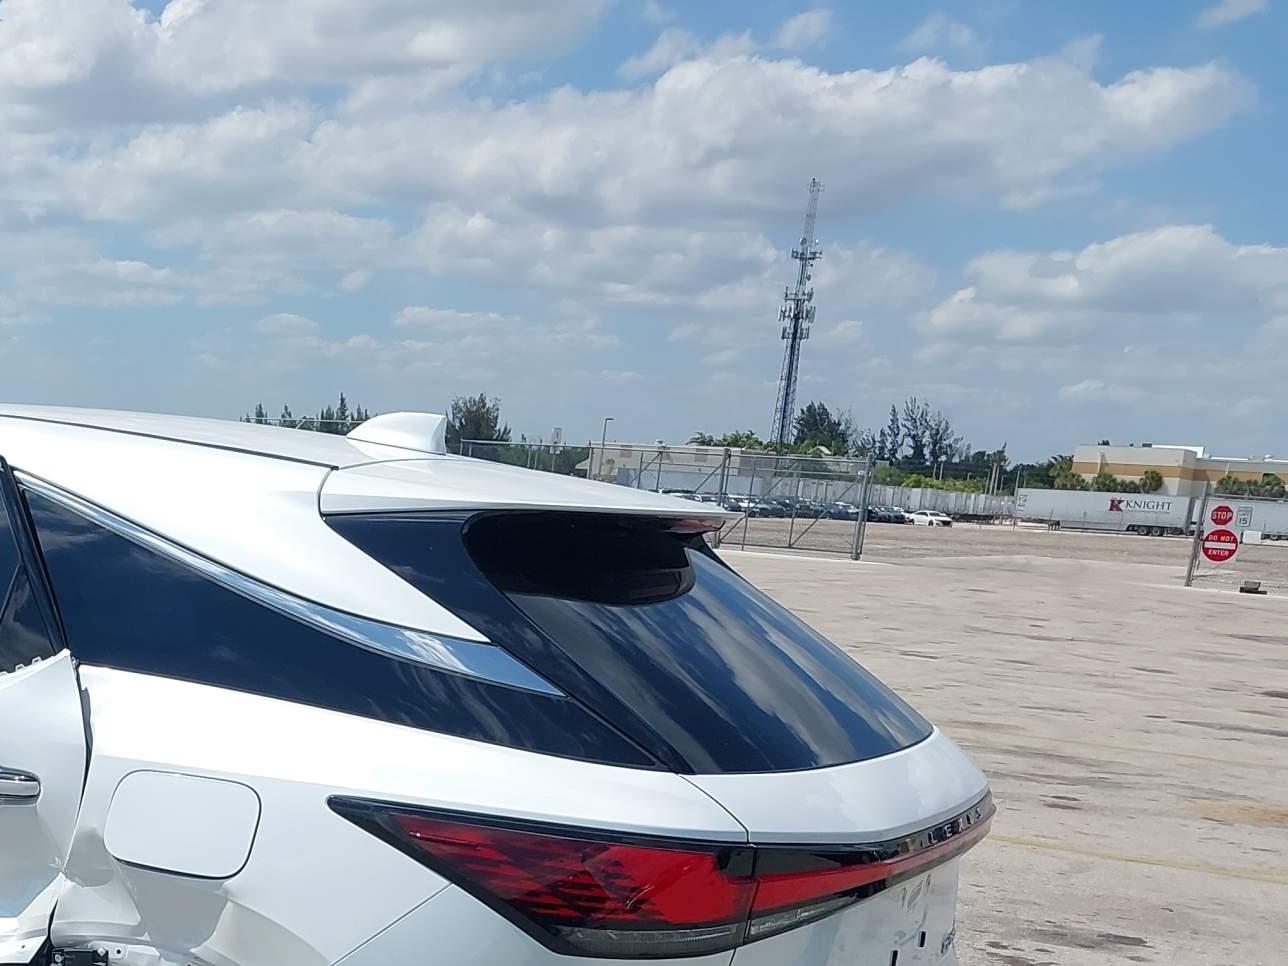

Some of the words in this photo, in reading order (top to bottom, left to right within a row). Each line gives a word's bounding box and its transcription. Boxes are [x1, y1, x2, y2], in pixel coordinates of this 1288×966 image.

[1126, 499, 1174, 511] KNIGHT
[1211, 511, 1233, 521] STOP
[1238, 517, 1248, 525] 15
[1207, 549, 1229, 557] ENTER
